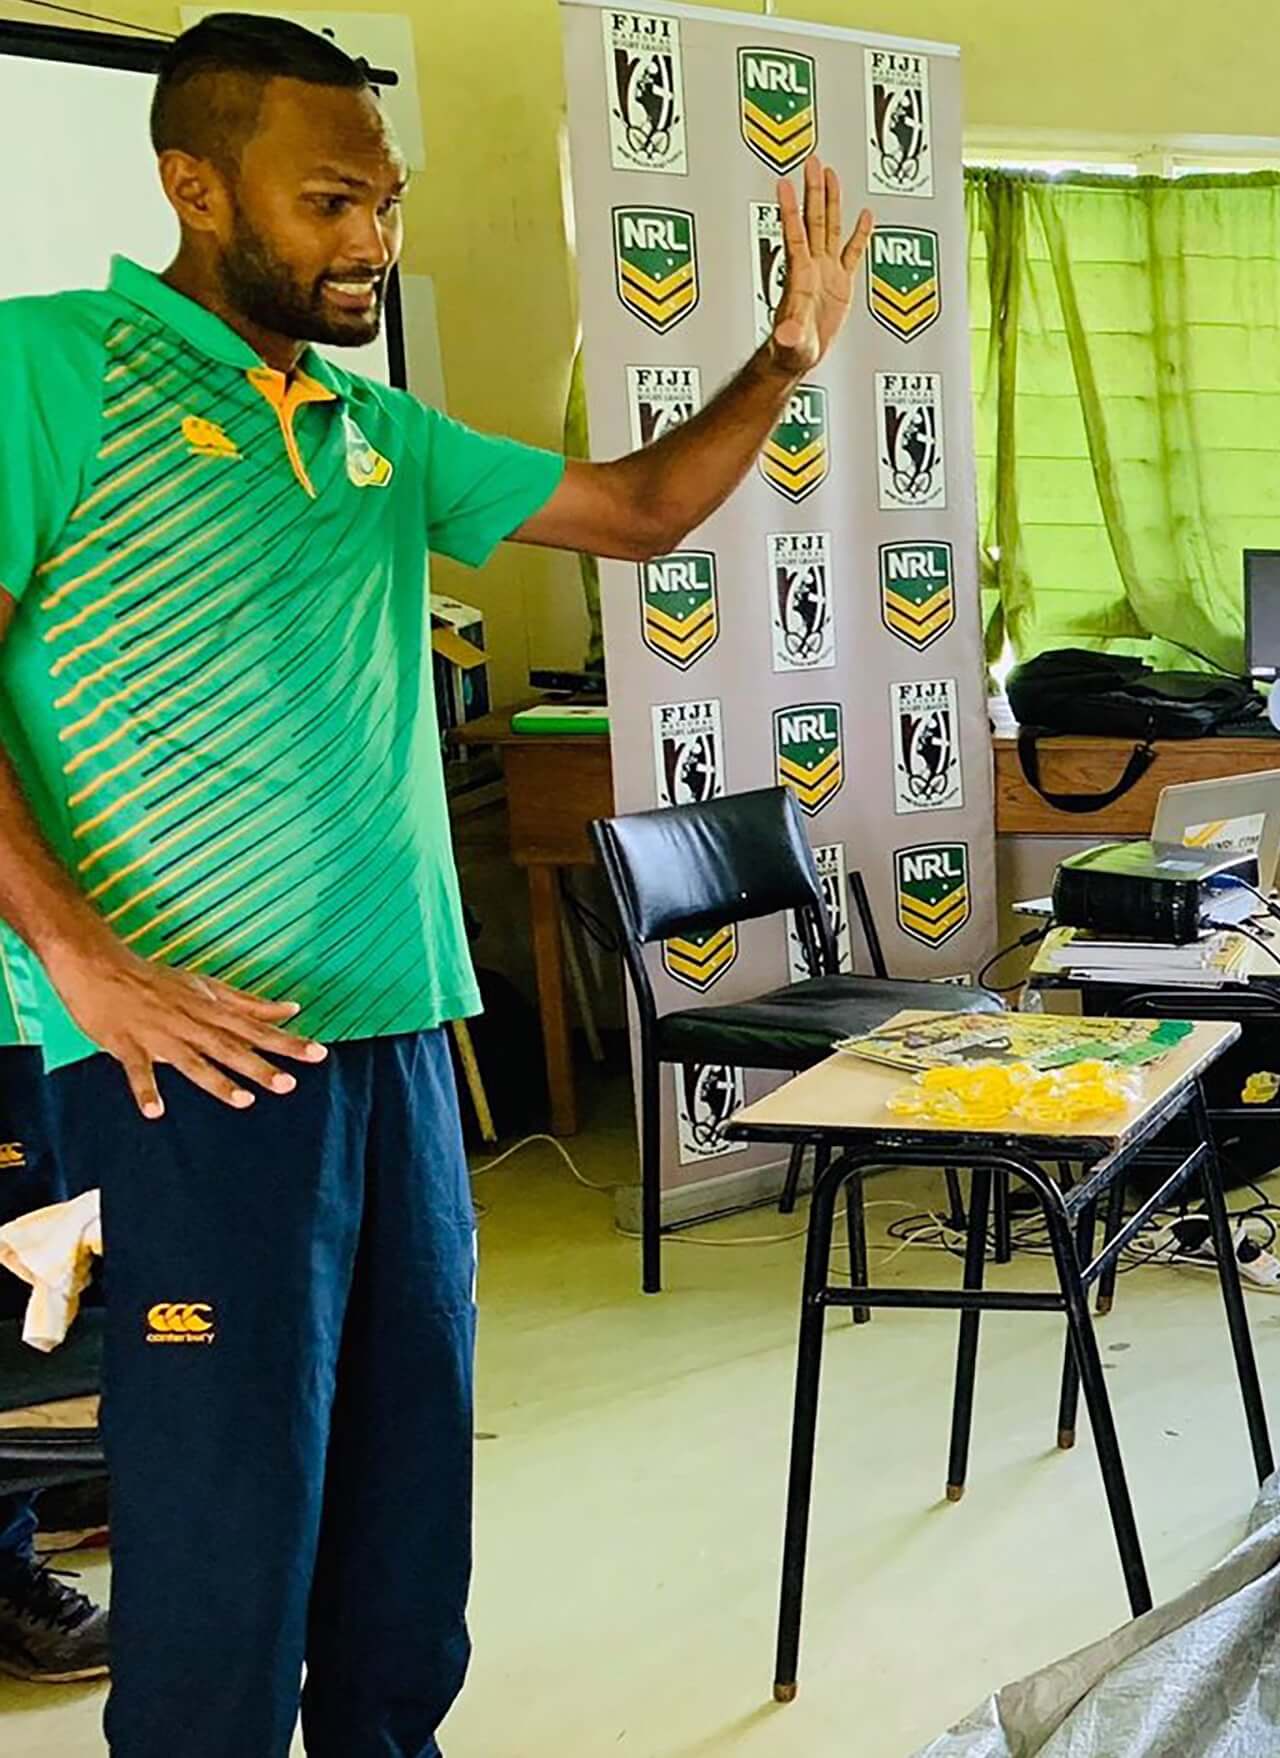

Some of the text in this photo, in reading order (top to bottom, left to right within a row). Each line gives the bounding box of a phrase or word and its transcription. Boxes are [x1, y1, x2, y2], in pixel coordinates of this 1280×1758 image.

[611, 13, 671, 38] FIJI
[872, 52, 920, 73] FIJI
[747, 58, 808, 95] NRL
[624, 216, 688, 251] NRL
[874, 235, 933, 268] NRL
[636, 369, 692, 386] FIJI
[883, 375, 933, 391] FIJI
[784, 395, 822, 425] RL
[775, 535, 824, 551] FIJI
[647, 563, 709, 593] NRL
[887, 551, 946, 579] NRL
[899, 682, 948, 699] FIJI
[661, 703, 713, 722] FIJI
[780, 713, 837, 746] NRL
[816, 847, 837, 863] JI
[903, 852, 963, 884] NRL
